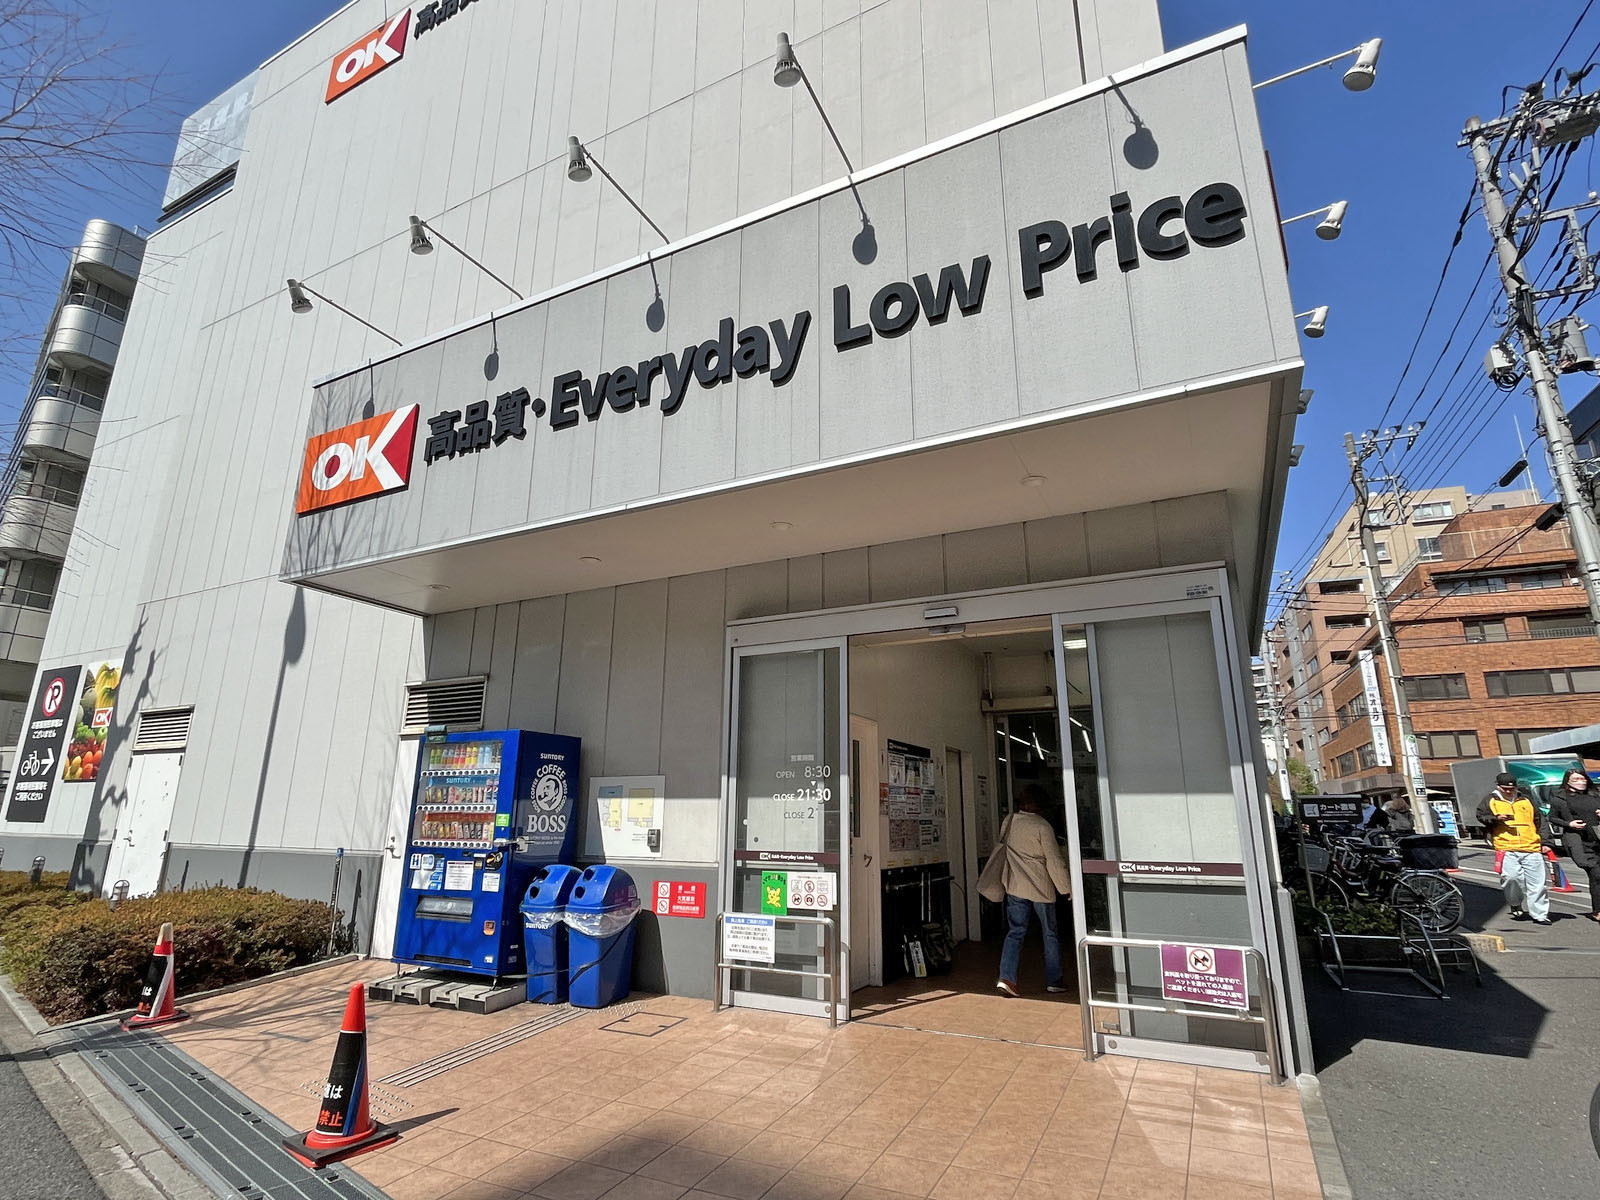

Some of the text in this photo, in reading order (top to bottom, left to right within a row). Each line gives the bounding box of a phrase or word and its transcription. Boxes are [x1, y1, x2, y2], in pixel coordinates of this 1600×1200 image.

[413, 0, 480, 40] 高品
[336, 8, 410, 83] OK
[833, 254, 992, 353] Low
[1018, 182, 1248, 300] Price
[312, 403, 418, 490] OK
[95, 708, 112, 724] OK
[540, 753, 565, 761] SUNTORY
[537, 764, 566, 780] COFFEE
[804, 765, 831, 778] 8:30
[796, 788, 831, 801] 21:30
[527, 814, 566, 833] BOSS
[319, 1110, 343, 1127] 禁止
